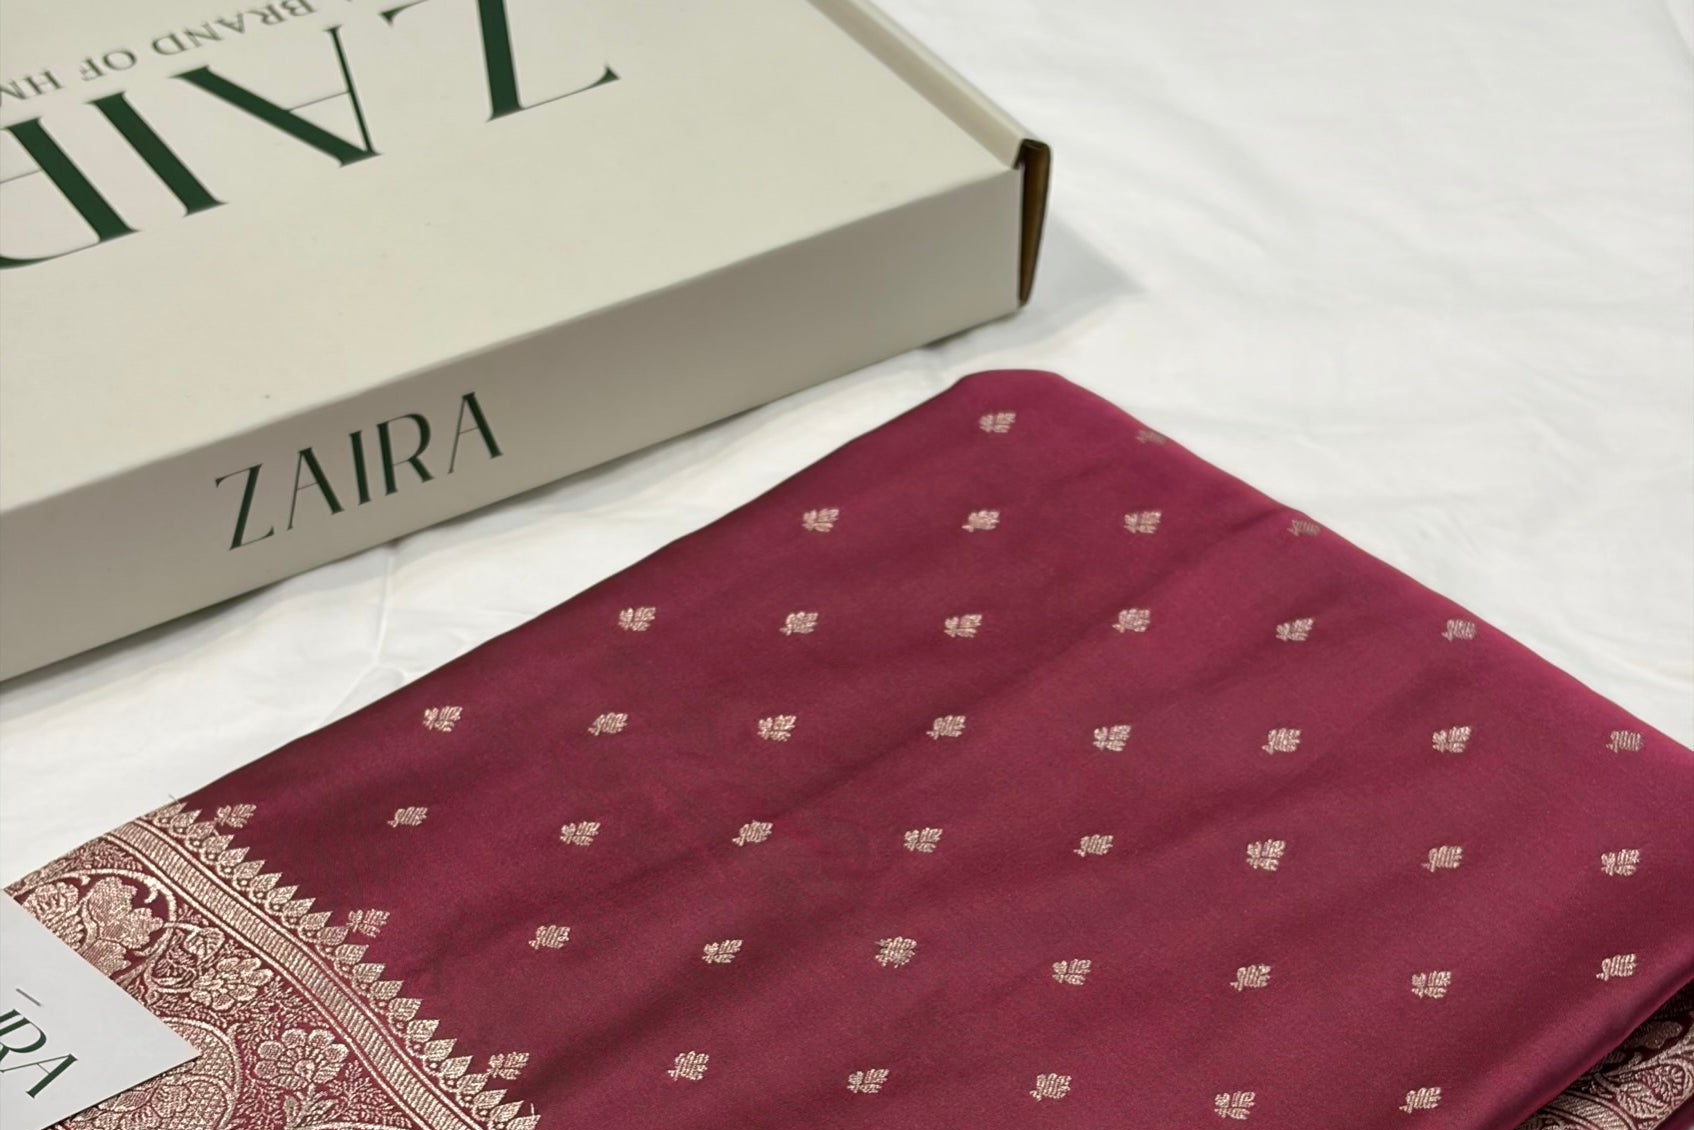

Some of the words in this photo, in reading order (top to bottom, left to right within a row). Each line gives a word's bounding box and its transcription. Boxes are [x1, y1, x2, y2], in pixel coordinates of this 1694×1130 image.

[151, 0, 317, 56] BRAND
[79, 50, 137, 81] OF
[214, 391, 504, 550] ZAIRA
